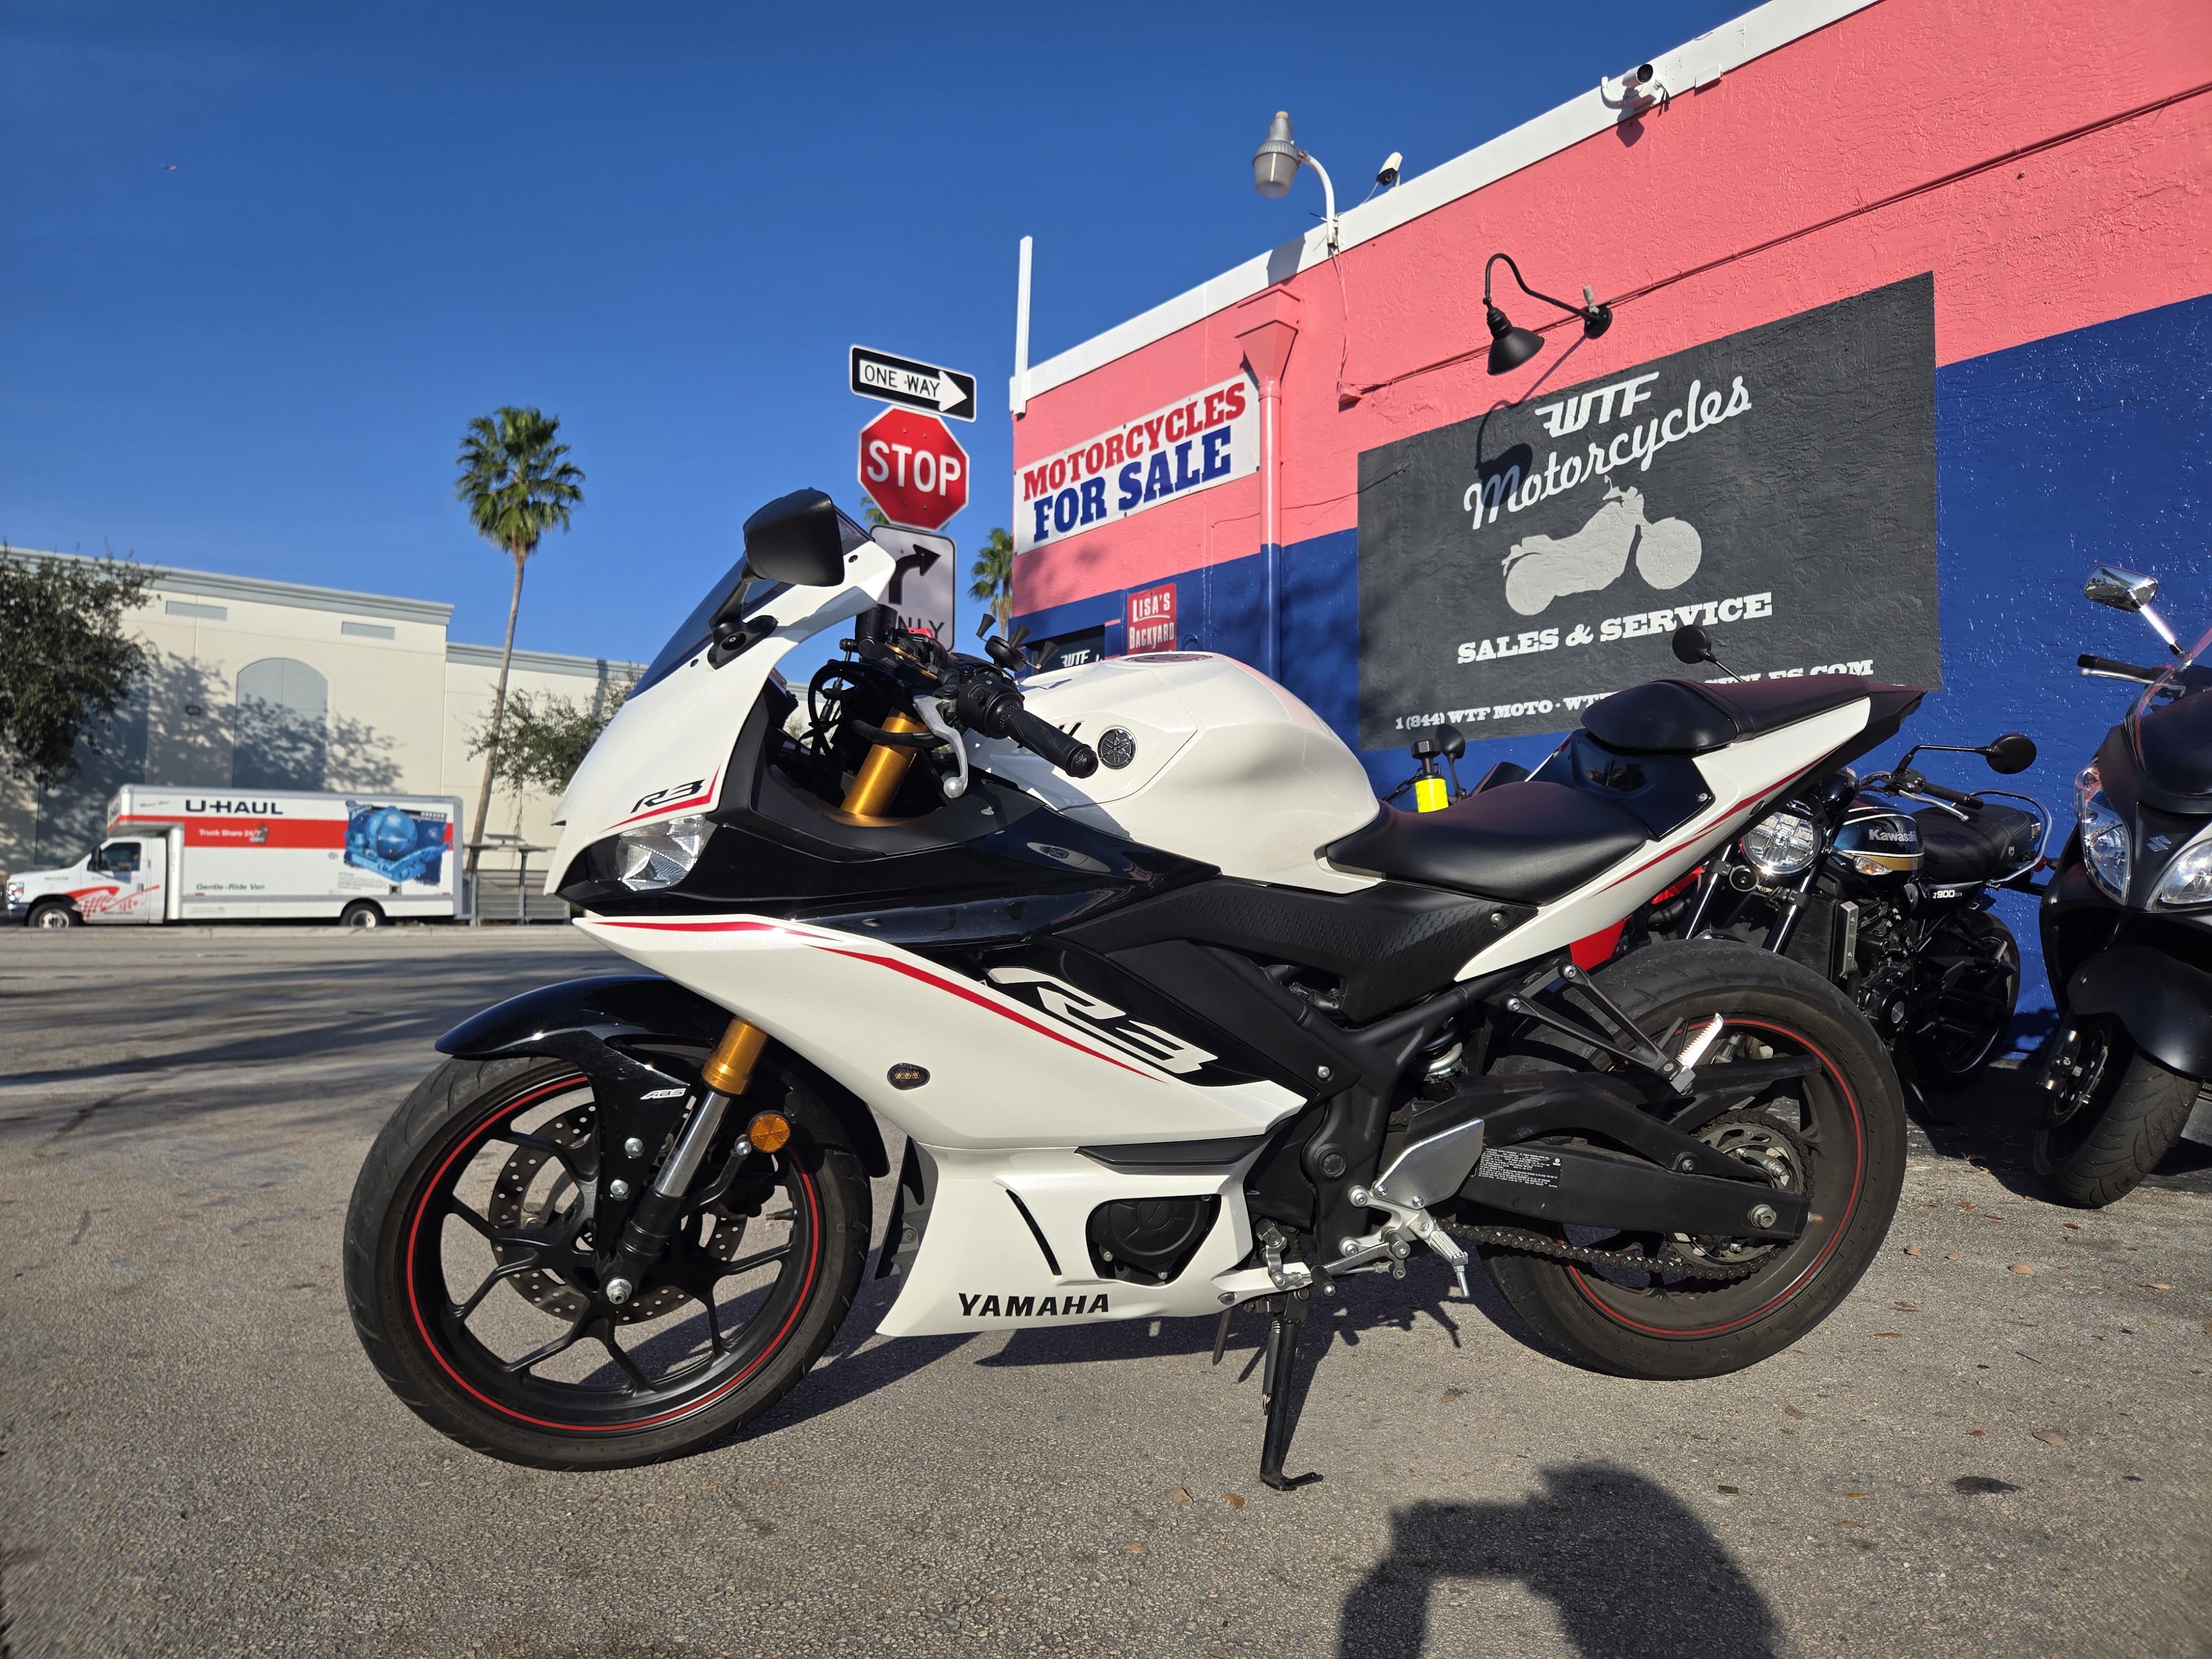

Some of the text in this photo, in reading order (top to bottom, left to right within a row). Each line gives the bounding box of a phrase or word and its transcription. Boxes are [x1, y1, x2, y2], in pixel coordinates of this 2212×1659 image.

[864, 364, 941, 399] ONE WAY
[1535, 372, 1660, 438] WTF
[1023, 382, 1246, 502] MOTORCYCLES
[1463, 375, 1752, 530] Motorcycles
[866, 440, 962, 497] STOP
[1033, 425, 1232, 544] FOR SALE
[1132, 592, 1171, 623] LISA'S
[1457, 592, 1773, 665] SALES & SERVICE
[1395, 717, 1404, 730] 1
[1405, 712, 1446, 730] (844)
[1447, 707, 1491, 724] WTF
[1493, 700, 1554, 719] MOTO
[185, 800, 284, 815] U-HAUL
[630, 779, 706, 814] R3
[199, 828, 220, 837] Truck
[1869, 829, 1917, 842] Kawasaki
[988, 967, 1218, 1074] R3
[640, 1088, 686, 1100] ABS
[957, 1293, 1110, 1317] YAMAHA
